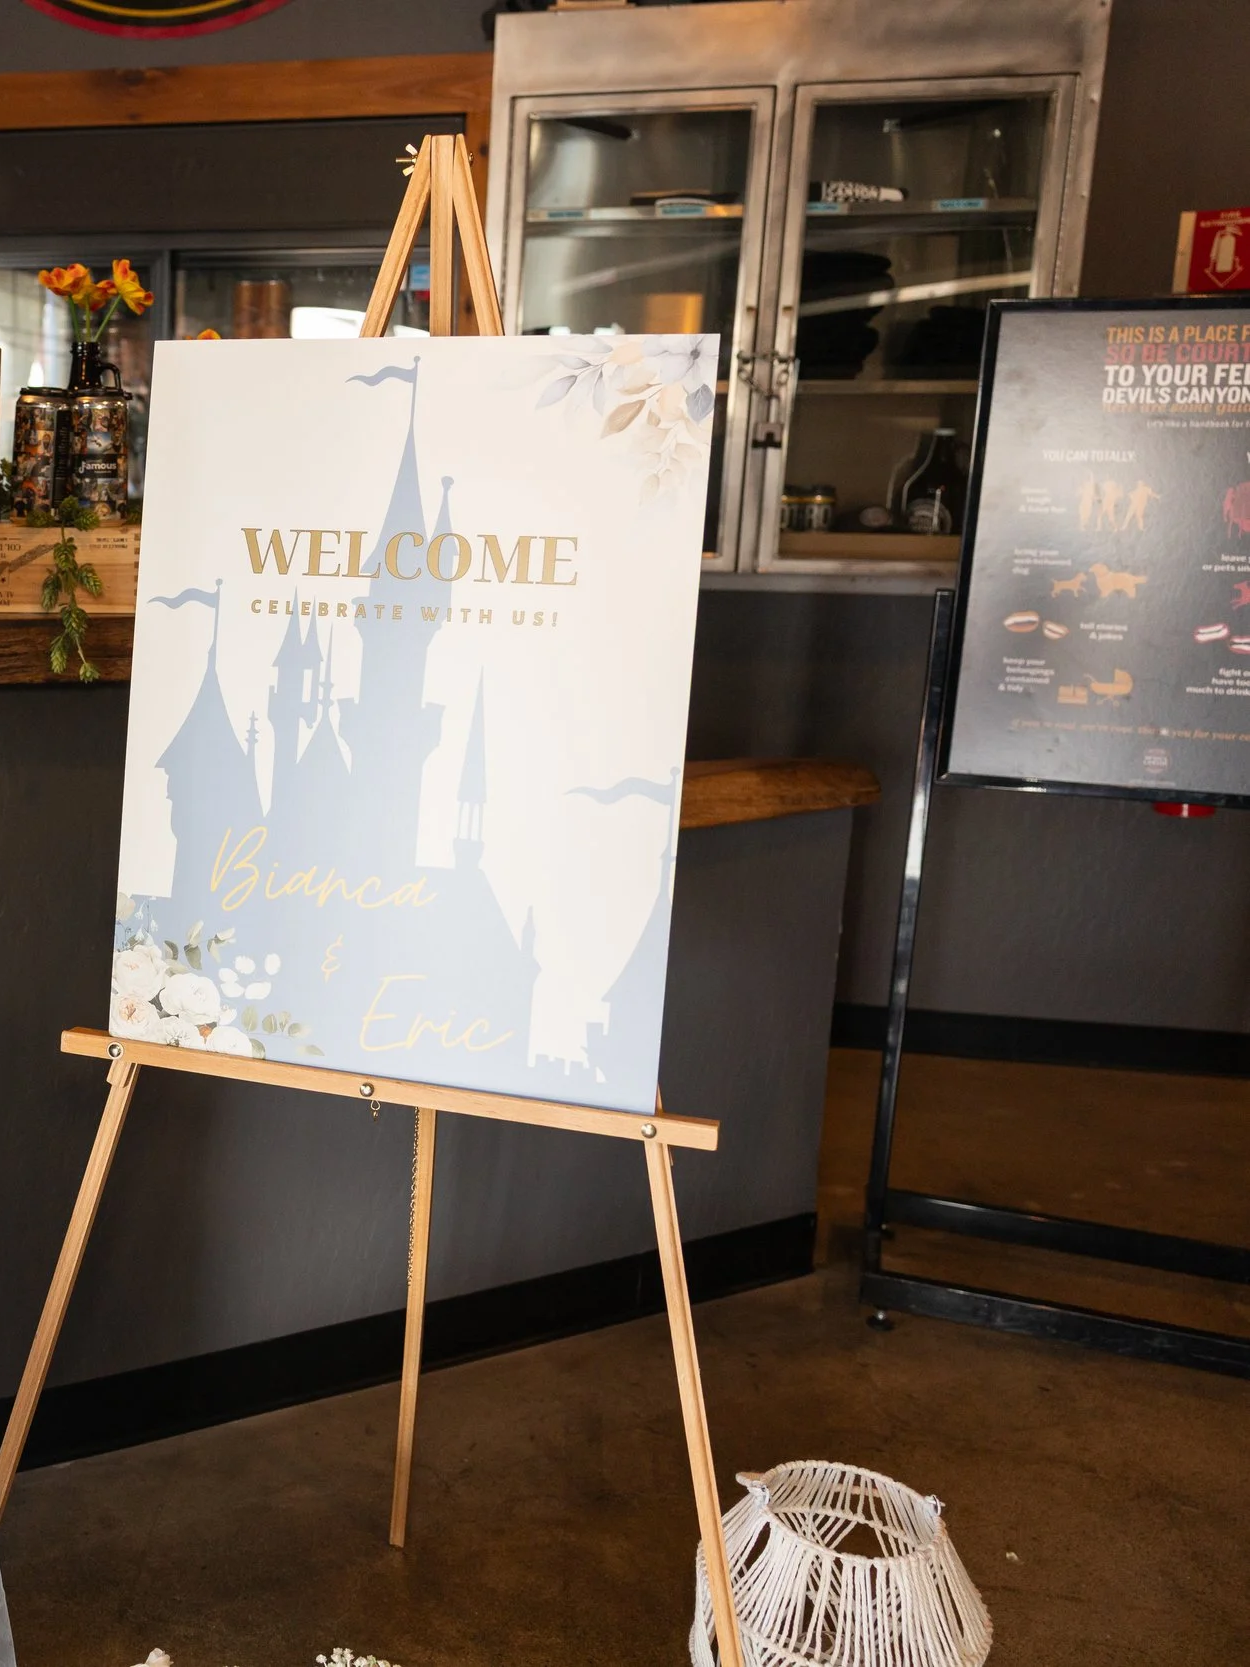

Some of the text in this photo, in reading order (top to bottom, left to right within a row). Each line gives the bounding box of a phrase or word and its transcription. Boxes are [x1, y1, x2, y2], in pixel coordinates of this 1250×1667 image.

[1107, 326, 1146, 344] THIS
[1148, 326, 1165, 343] IS
[1168, 325, 1180, 342] A
[1183, 324, 1238, 342] PLACE
[1105, 344, 1136, 364] SO
[1141, 344, 1170, 363] BE
[1104, 364, 1136, 387] TO
[1142, 364, 1209, 386] YOUR
[1102, 387, 1172, 405] DEVIL'S
[1190, 419, 1229, 428] handbook
[1043, 449, 1064, 461] YOU
[1065, 450, 1089, 462] CAN
[241, 526, 579, 587] WELCOME
[1221, 553, 1247, 563] leave
[1203, 564, 1213, 572] or
[1214, 563, 1235, 573] pets
[251, 598, 559, 629] CELEBRATE WITH US!
[1186, 686, 1213, 695] much
[1214, 686, 1225, 695] to
[1211, 677, 1235, 686] have
[210, 826, 439, 912] Bianca
[321, 934, 344, 983] &
[359, 974, 515, 1053] Eric
